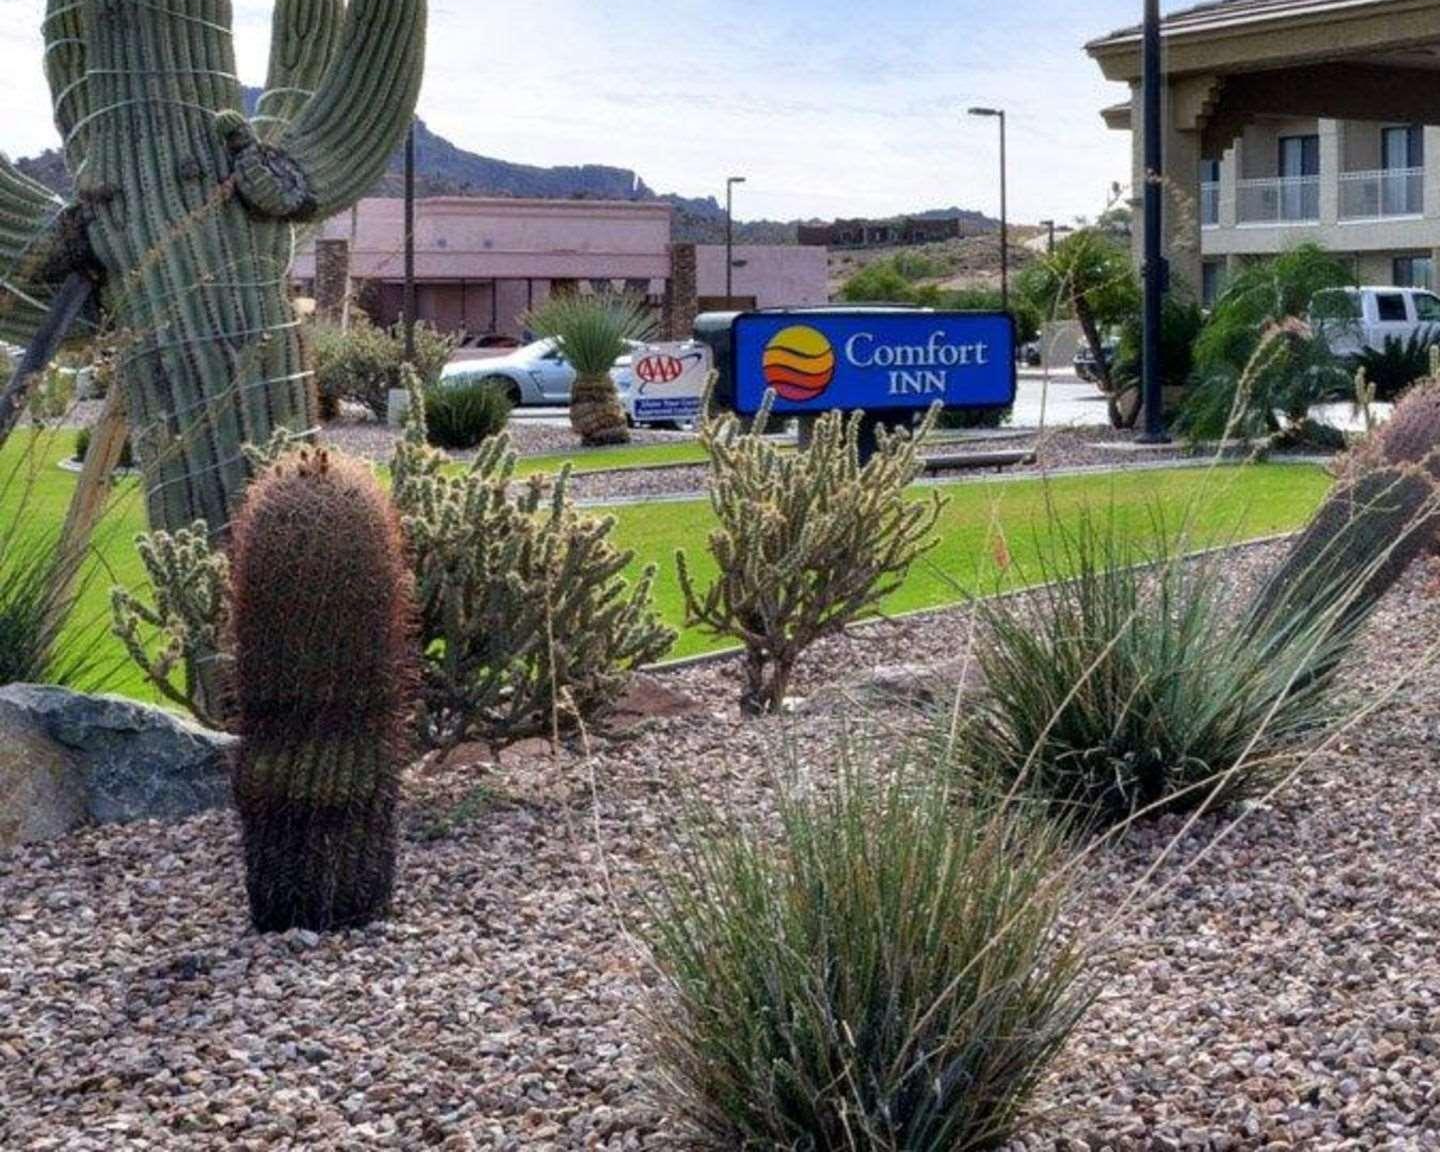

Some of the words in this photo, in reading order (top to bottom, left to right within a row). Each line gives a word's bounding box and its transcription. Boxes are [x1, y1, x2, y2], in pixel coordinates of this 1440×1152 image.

[845, 330, 988, 367] Comfort
[638, 356, 681, 382] AAA
[888, 370, 947, 394] INN
